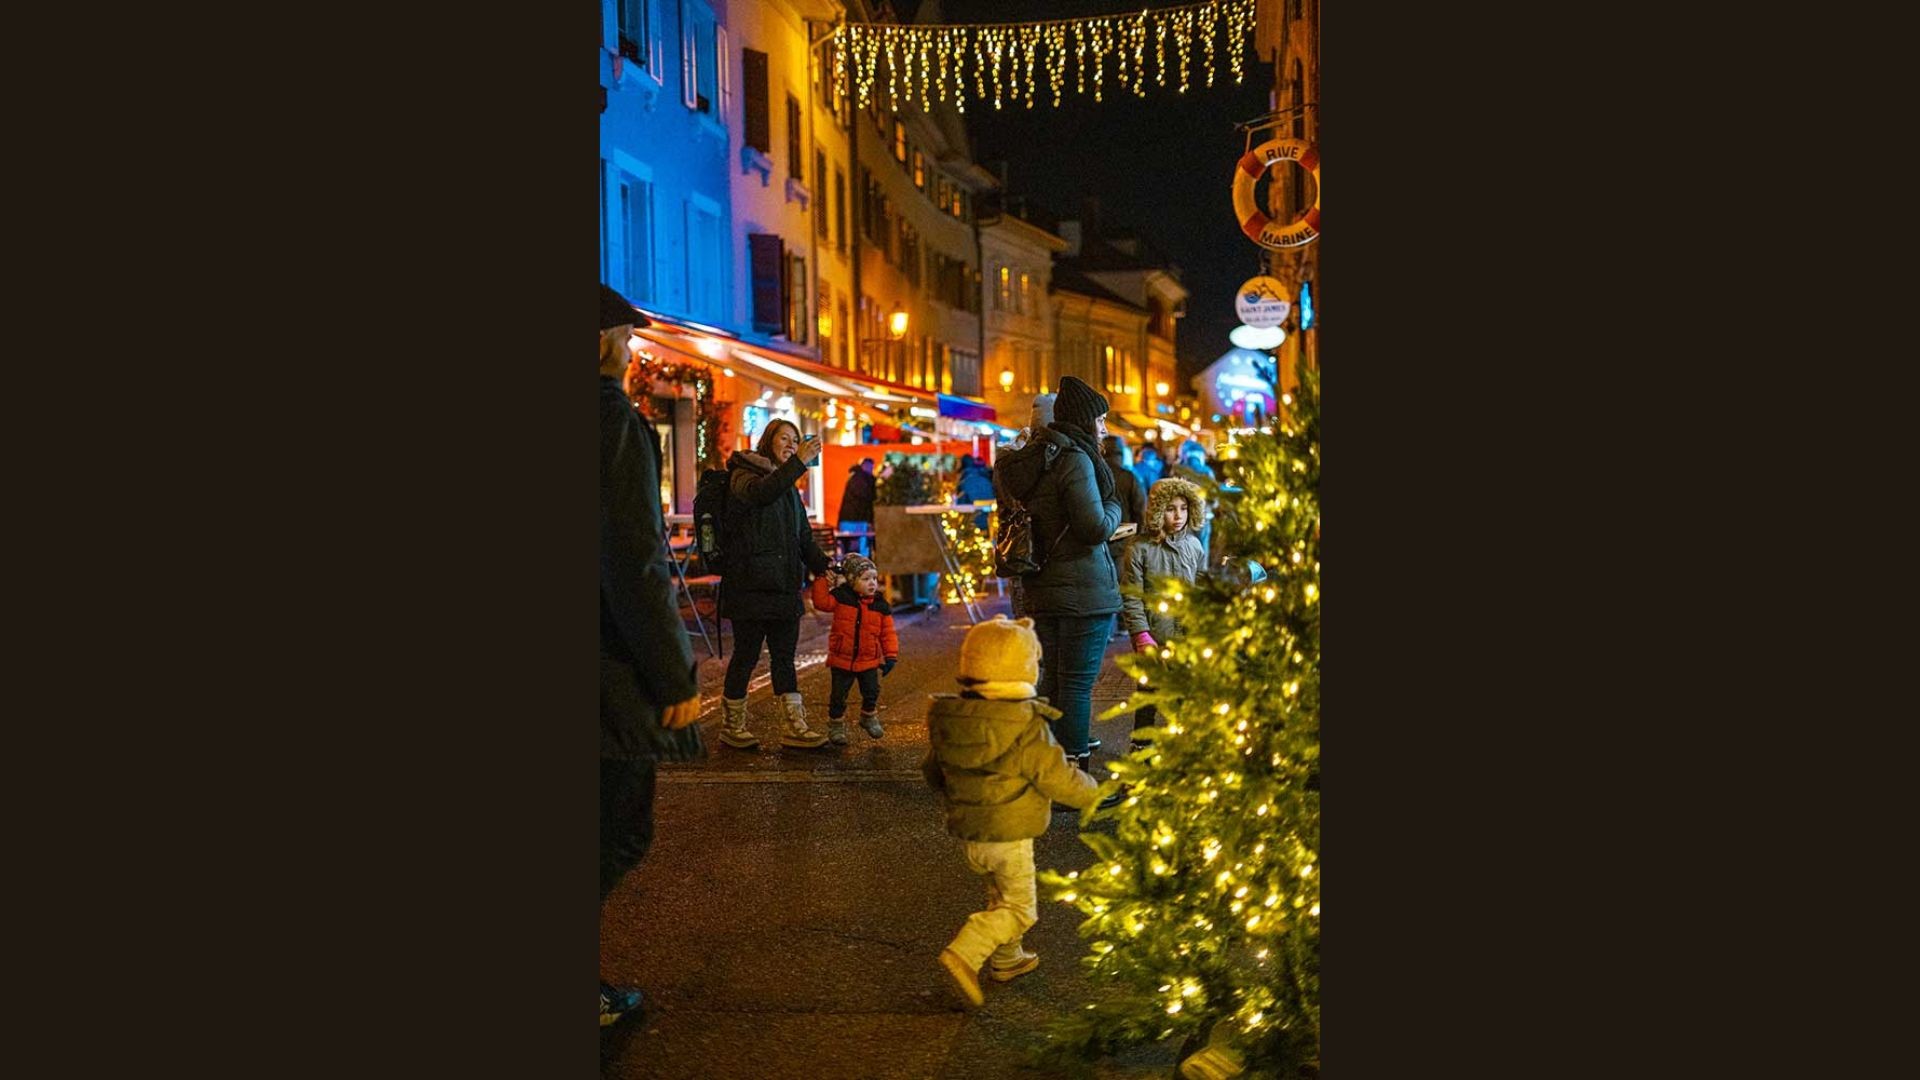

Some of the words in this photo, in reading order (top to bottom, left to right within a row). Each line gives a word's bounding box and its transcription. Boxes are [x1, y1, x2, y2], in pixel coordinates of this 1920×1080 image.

[1266, 147, 1299, 160] RIVE
[1261, 228, 1315, 245] MARINE
[1263, 304, 1286, 313] JAMES
